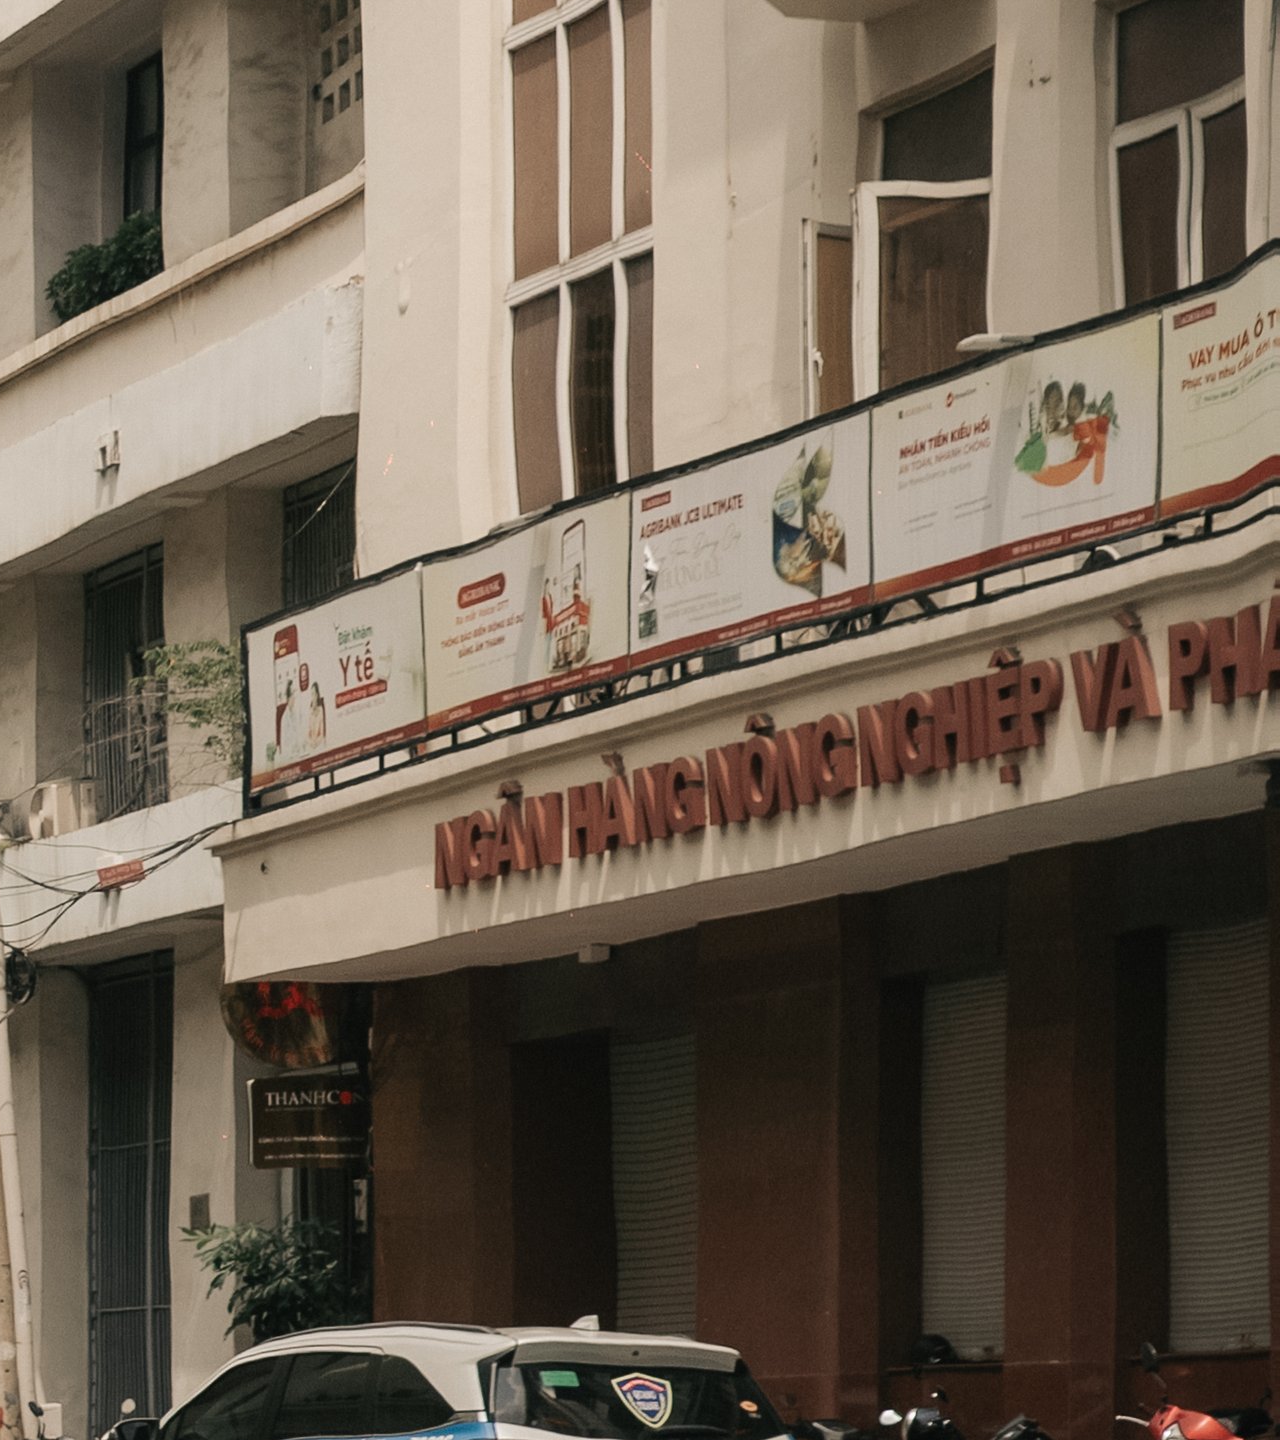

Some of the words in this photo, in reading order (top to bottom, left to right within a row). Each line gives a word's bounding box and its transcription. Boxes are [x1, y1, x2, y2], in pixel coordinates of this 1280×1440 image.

[1188, 345, 1215, 370] VAY
[1218, 329, 1249, 360] MUA
[701, 494, 743, 520] ULTIMATE
[339, 655, 350, 687] Y
[354, 640, 373, 682] tế
[434, 780, 563, 889] NGÂN
[568, 752, 707, 858] HÀNG
[706, 714, 858, 826] NÔNG
[857, 647, 1064, 788] NGHIỆP
[1070, 603, 1163, 732] VÀ
